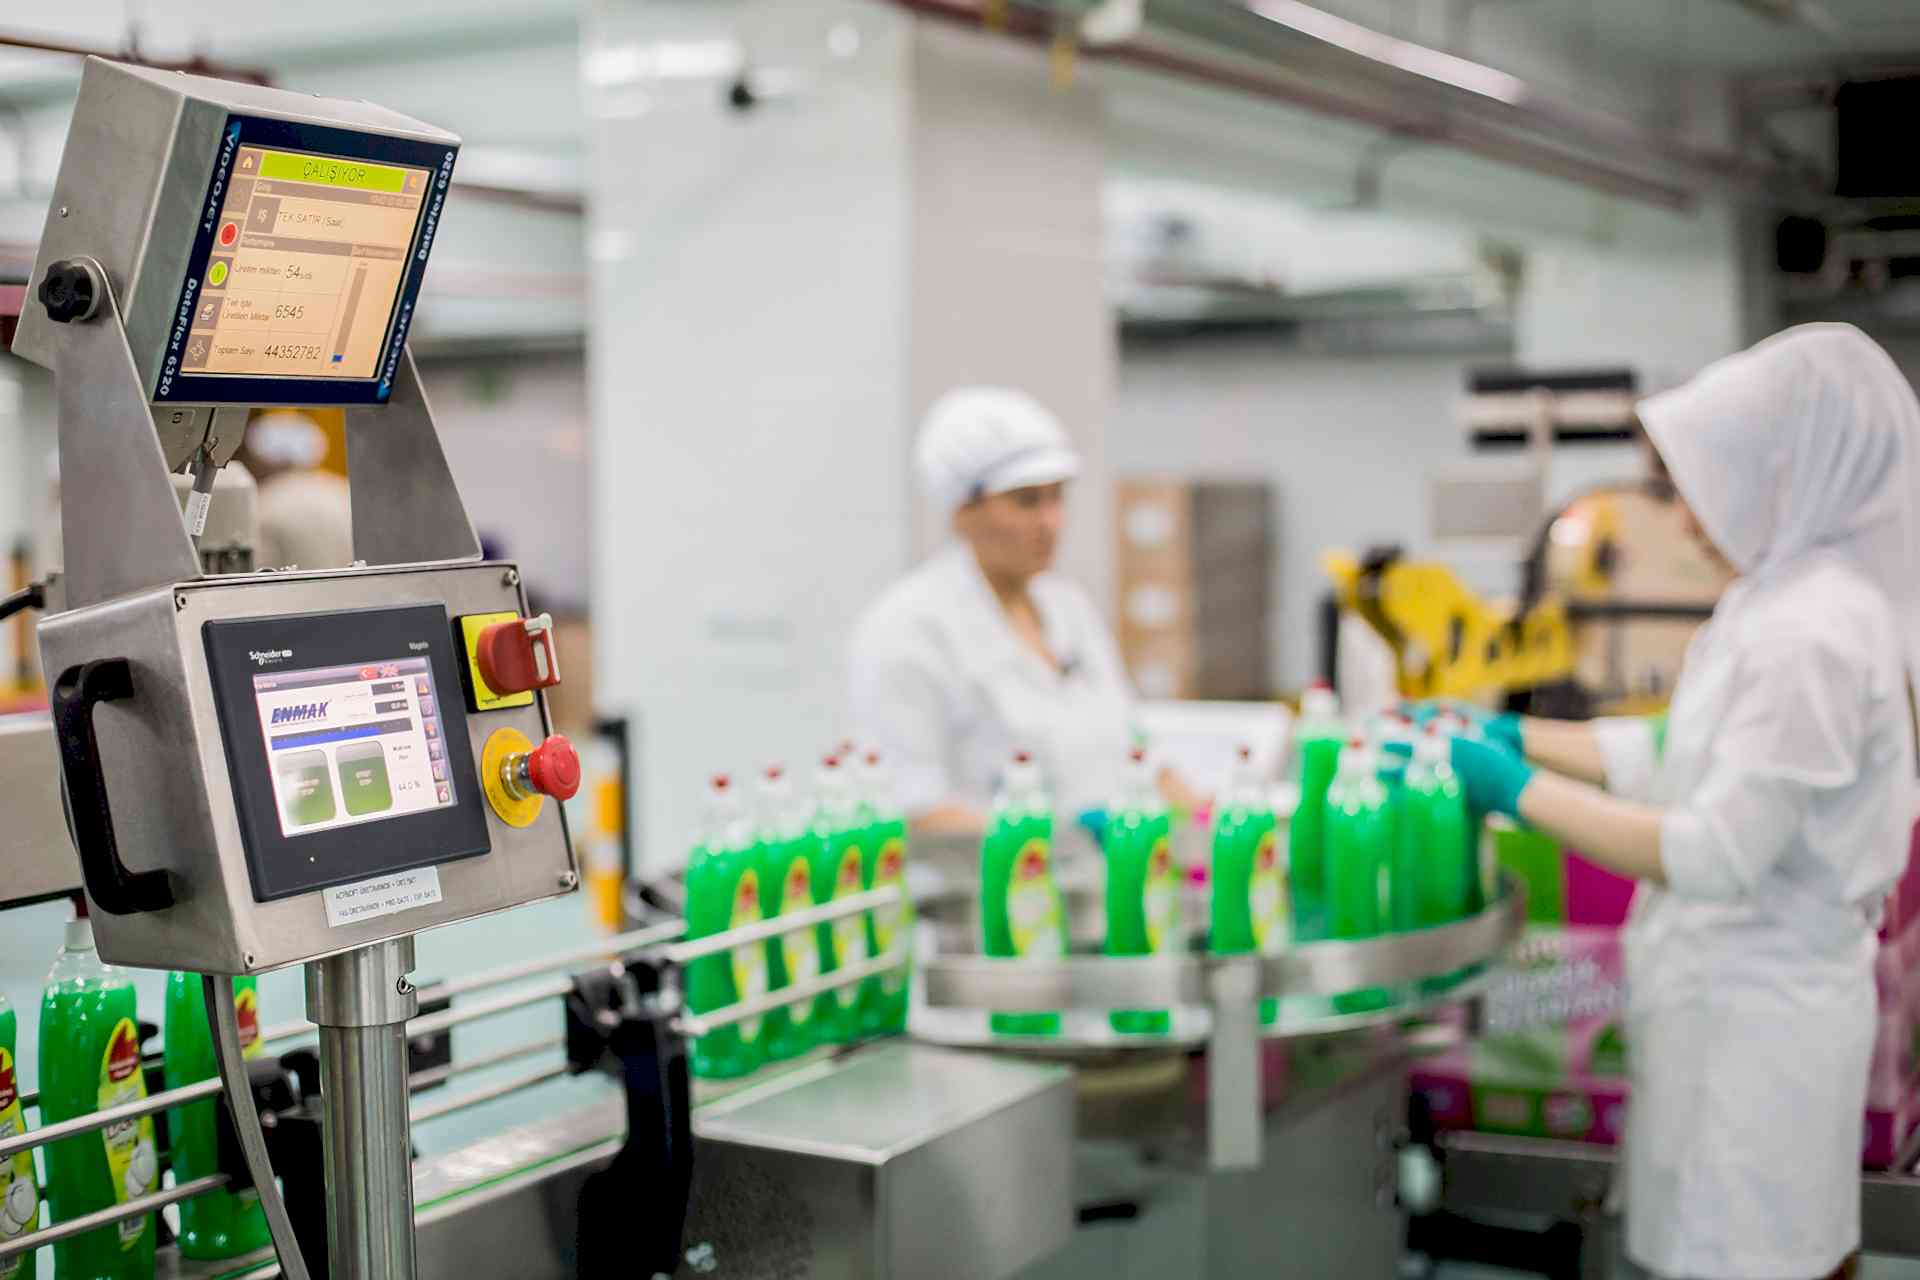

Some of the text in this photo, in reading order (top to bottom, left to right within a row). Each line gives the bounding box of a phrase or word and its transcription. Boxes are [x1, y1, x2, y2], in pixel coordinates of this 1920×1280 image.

[437, 151, 454, 189] 6320
[286, 264, 300, 280] 54
[275, 304, 304, 320] 6545
[264, 344, 321, 360] 44352782
[160, 356, 178, 396] 6320
[271, 702, 329, 724] ENMAK
